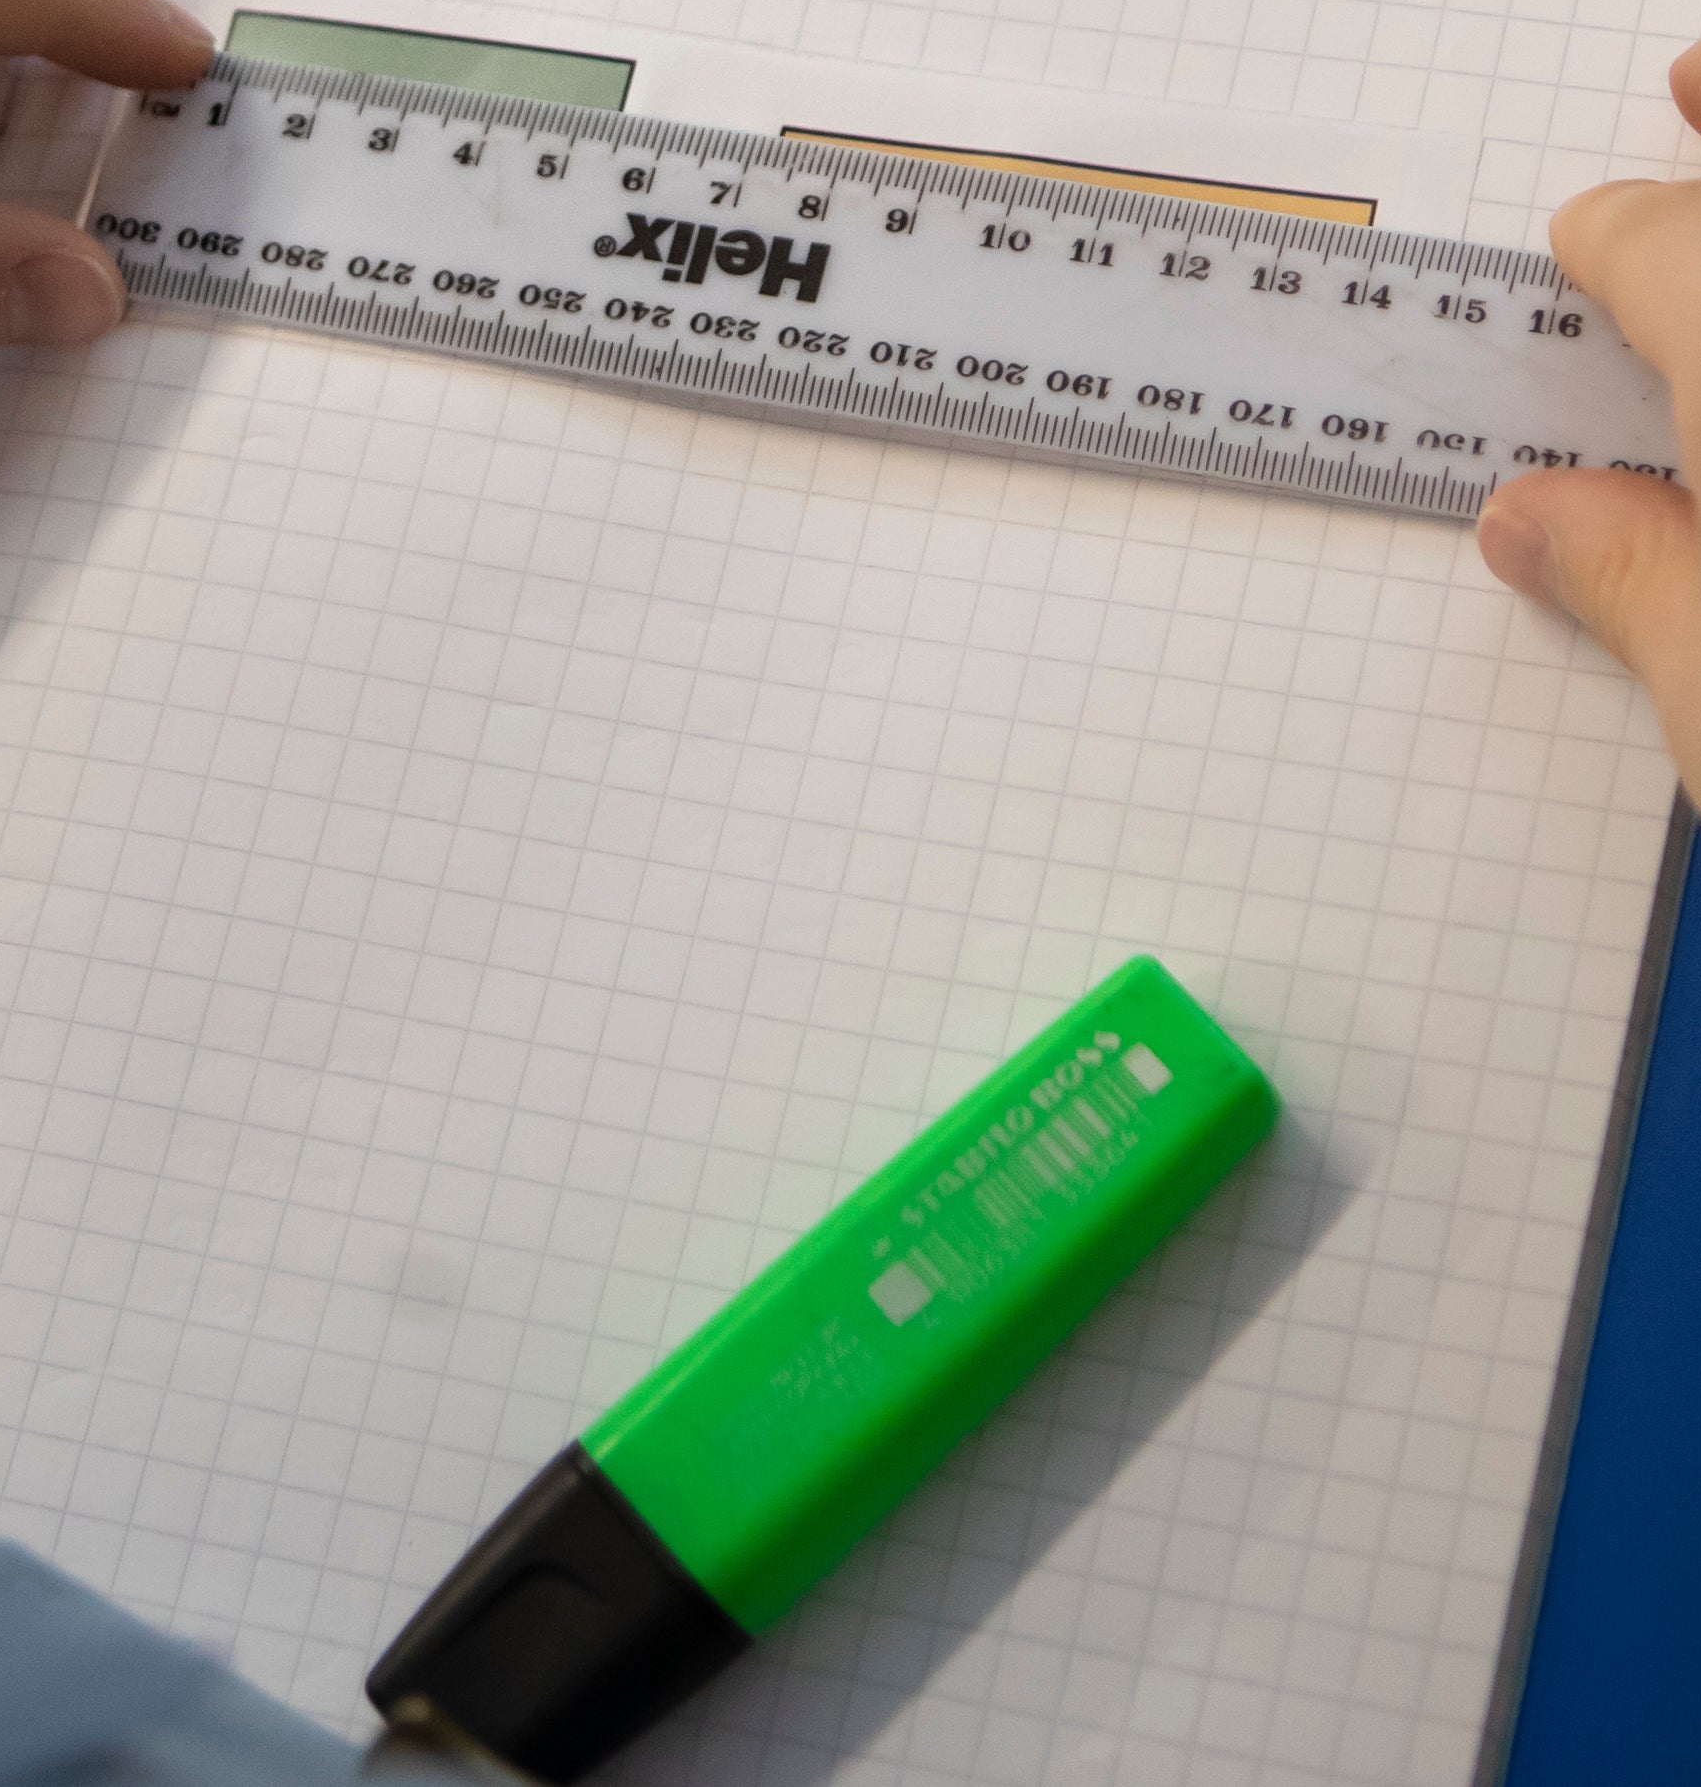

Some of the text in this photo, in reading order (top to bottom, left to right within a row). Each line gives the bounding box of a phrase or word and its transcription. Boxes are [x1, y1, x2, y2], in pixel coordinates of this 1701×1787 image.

[96, 214, 162, 243] 300
[177, 226, 243, 256] 290
[283, 114, 306, 139] 2
[368, 127, 392, 152] 3
[452, 141, 475, 166] 4
[536, 154, 558, 179] 5
[622, 167, 645, 192] 6
[710, 181, 732, 206] 7
[799, 195, 821, 220] 8
[885, 208, 909, 233] 9
[979, 223, 1031, 252] 10
[1069, 238, 1115, 267] 11
[1159, 252, 1211, 281] 12
[1250, 267, 1303, 295] 13
[1342, 281, 1393, 310] 14
[1435, 295, 1487, 323] 15
[1528, 309, 1583, 338] 16
[261, 241, 328, 271] 280
[347, 255, 416, 285] 270
[433, 269, 500, 299] 260
[518, 283, 586, 312] 250
[604, 297, 675, 328] 240
[690, 311, 760, 341] 230
[777, 326, 850, 356] 220
[869, 341, 938, 370] 210
[956, 354, 1029, 385] 200
[1046, 369, 1113, 400] 190
[1136, 384, 1206, 414] 180
[1229, 399, 1297, 429] 170
[1321, 413, 1389, 443] 160
